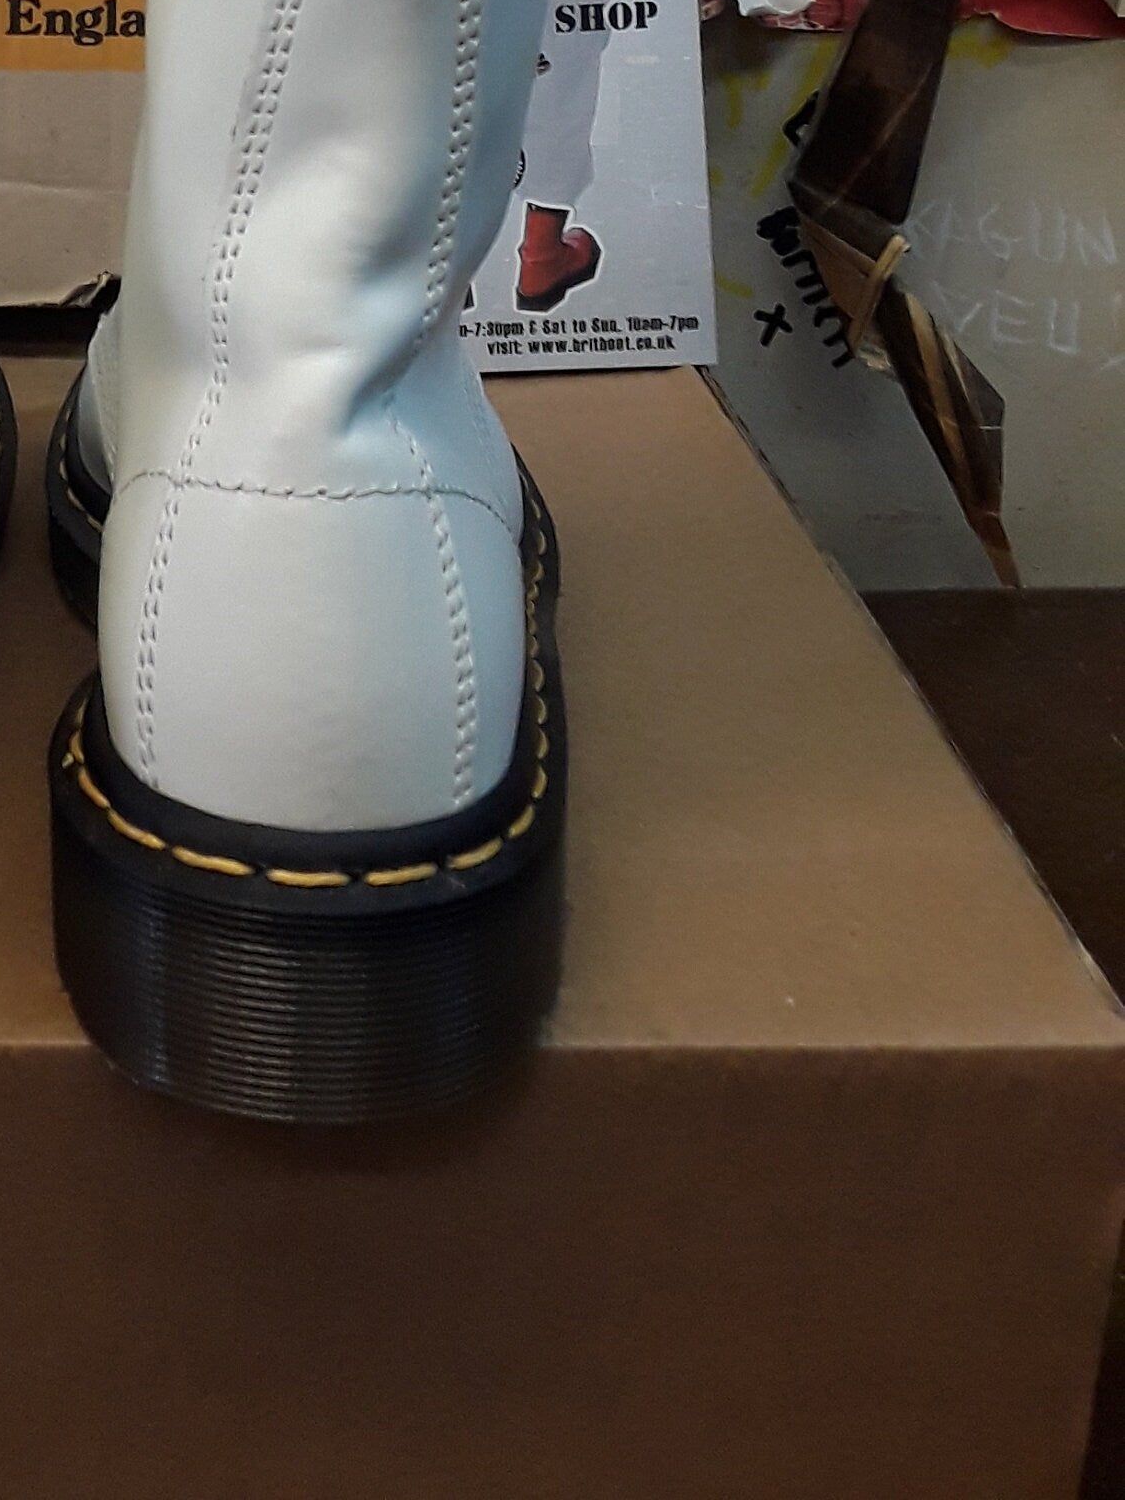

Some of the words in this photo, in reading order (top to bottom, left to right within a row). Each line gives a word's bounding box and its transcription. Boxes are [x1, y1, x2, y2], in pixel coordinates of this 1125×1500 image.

[555, 1, 658, 34] SHOP
[542, 319, 567, 335] Sat
[572, 318, 587, 334] to
